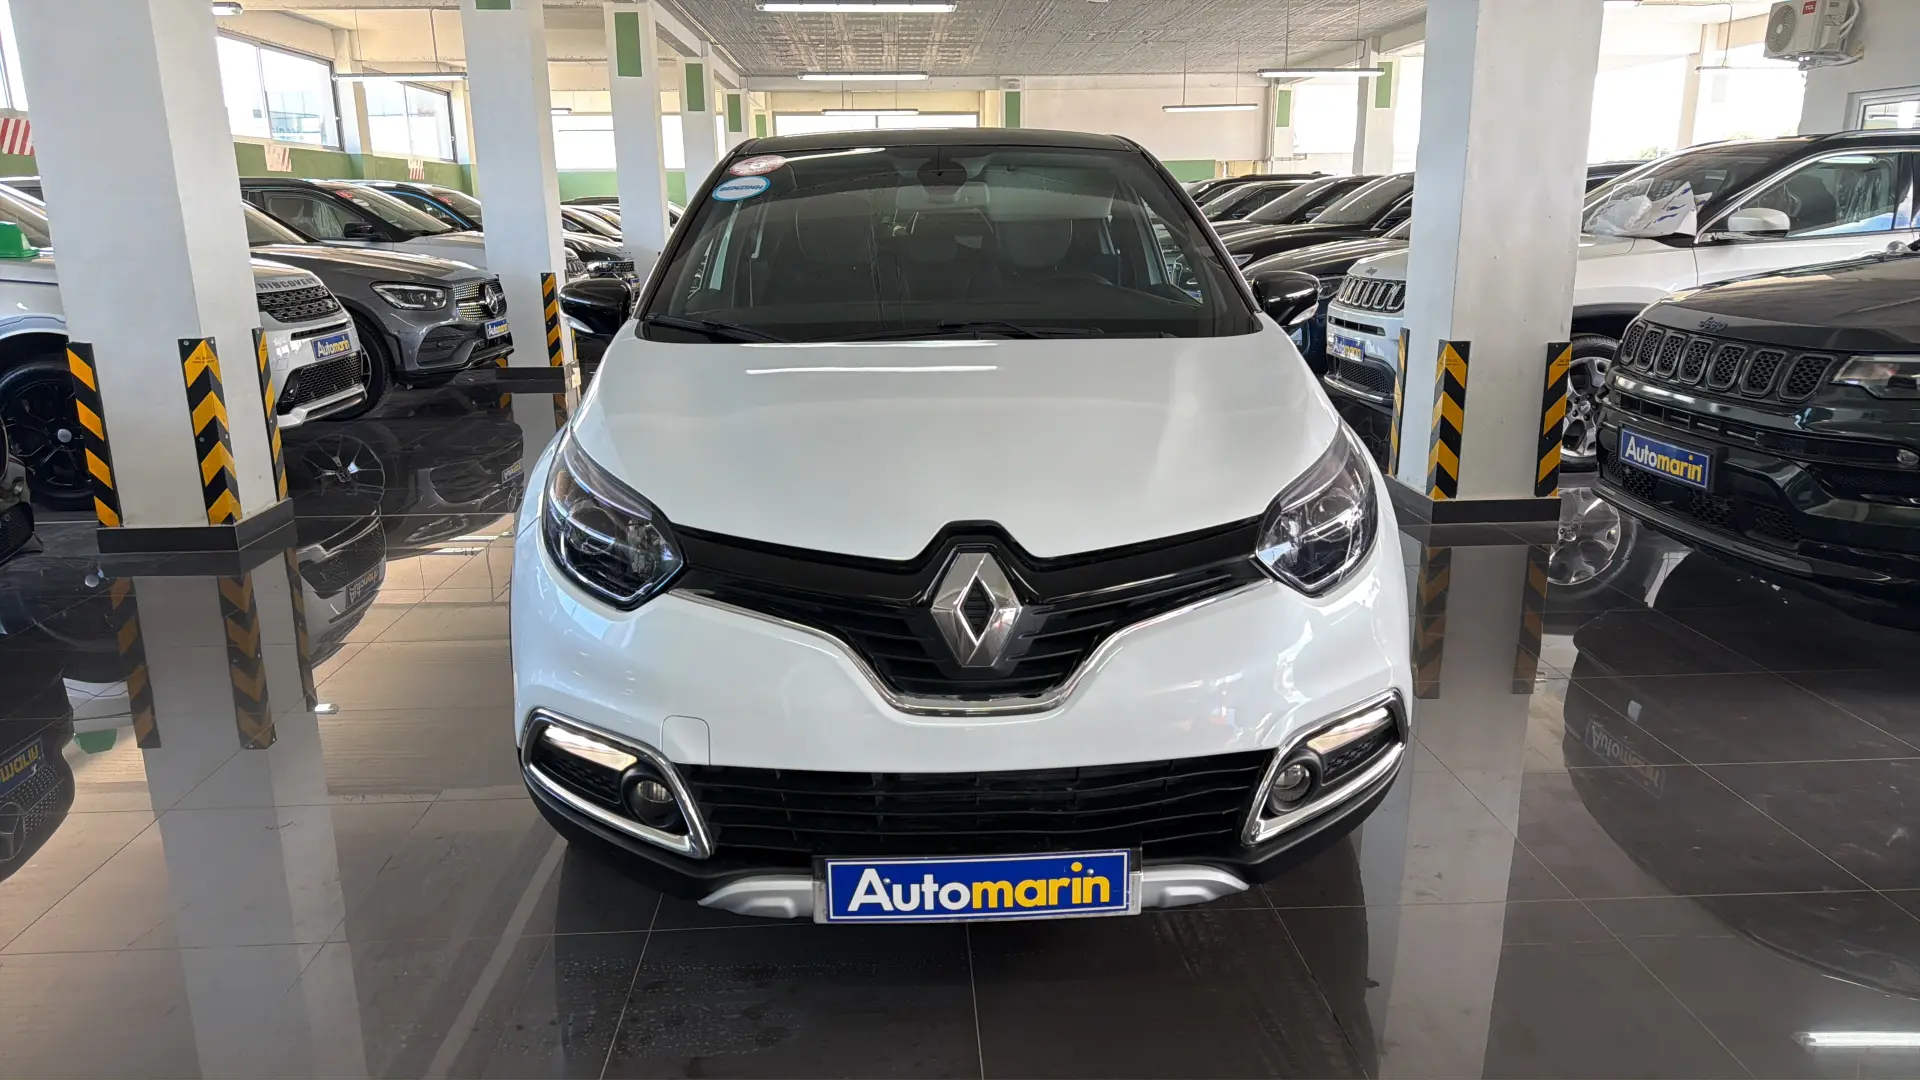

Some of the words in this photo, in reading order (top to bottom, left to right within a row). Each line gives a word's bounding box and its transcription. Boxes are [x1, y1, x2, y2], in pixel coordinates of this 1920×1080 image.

[257, 278, 317, 290] DISCOVERY
[318, 336, 351, 357] Automarin
[1625, 435, 1703, 482] Automarin
[847, 862, 1110, 911] Automarin
